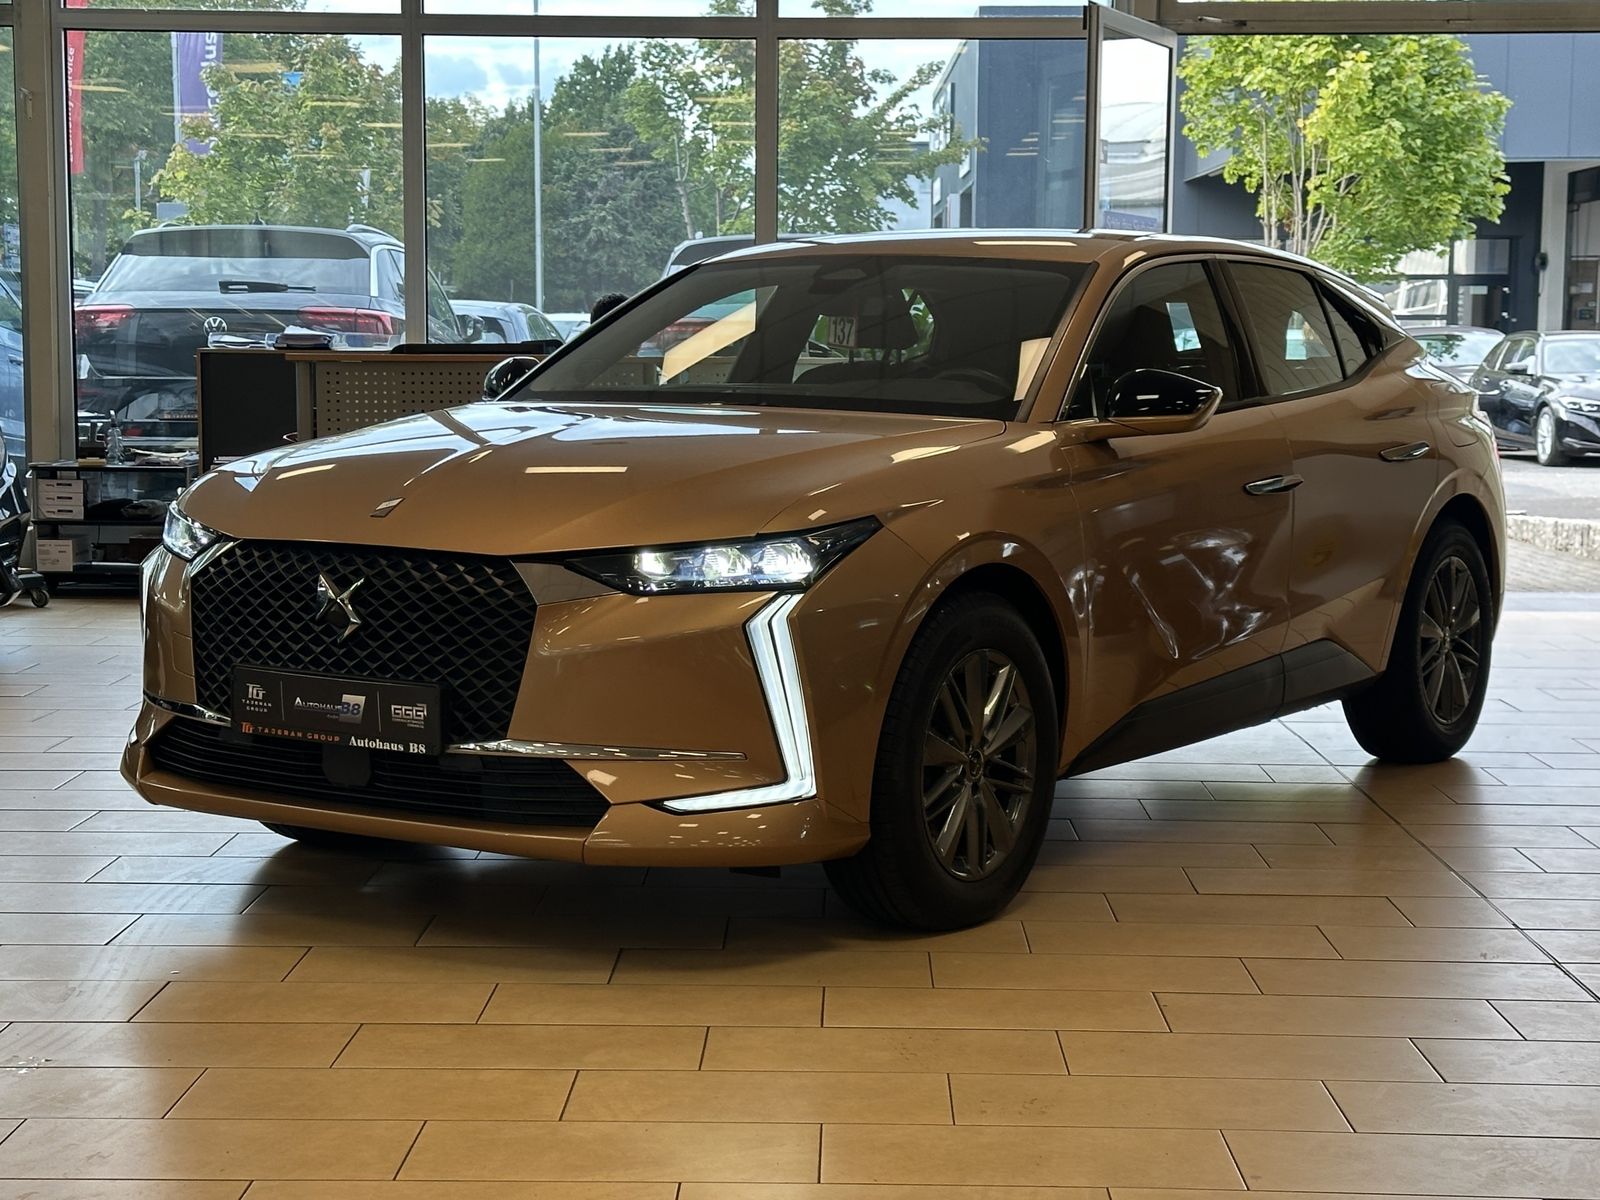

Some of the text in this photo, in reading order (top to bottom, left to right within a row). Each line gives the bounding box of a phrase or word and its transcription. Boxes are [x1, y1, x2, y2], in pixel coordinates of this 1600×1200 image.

[832, 318, 854, 345] 137
[340, 702, 362, 716] B8
[257, 727, 303, 738] TAJERAN
[306, 732, 341, 742] GROUP
[349, 735, 426, 755] Autohaus B8
